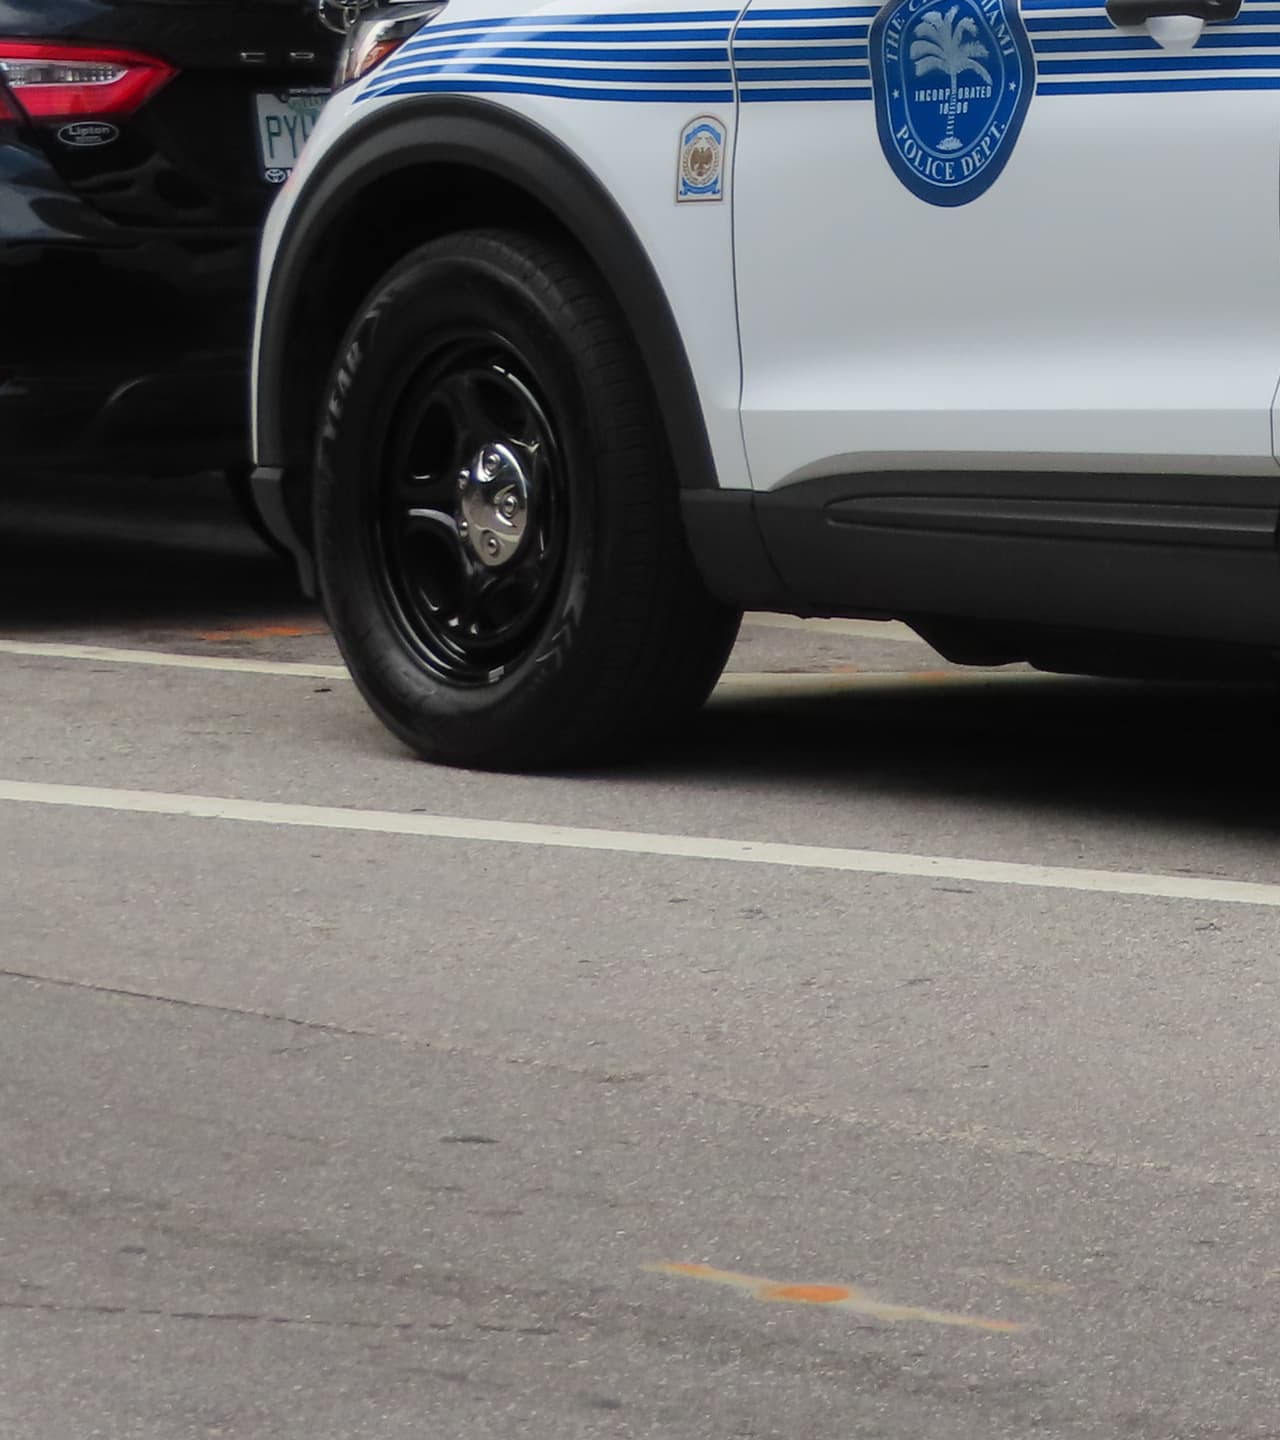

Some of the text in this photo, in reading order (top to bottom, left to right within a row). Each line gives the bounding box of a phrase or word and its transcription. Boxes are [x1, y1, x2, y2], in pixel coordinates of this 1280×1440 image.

[886, 15, 907, 63] THE
[896, 122, 1007, 181] POLICE DEPT.
